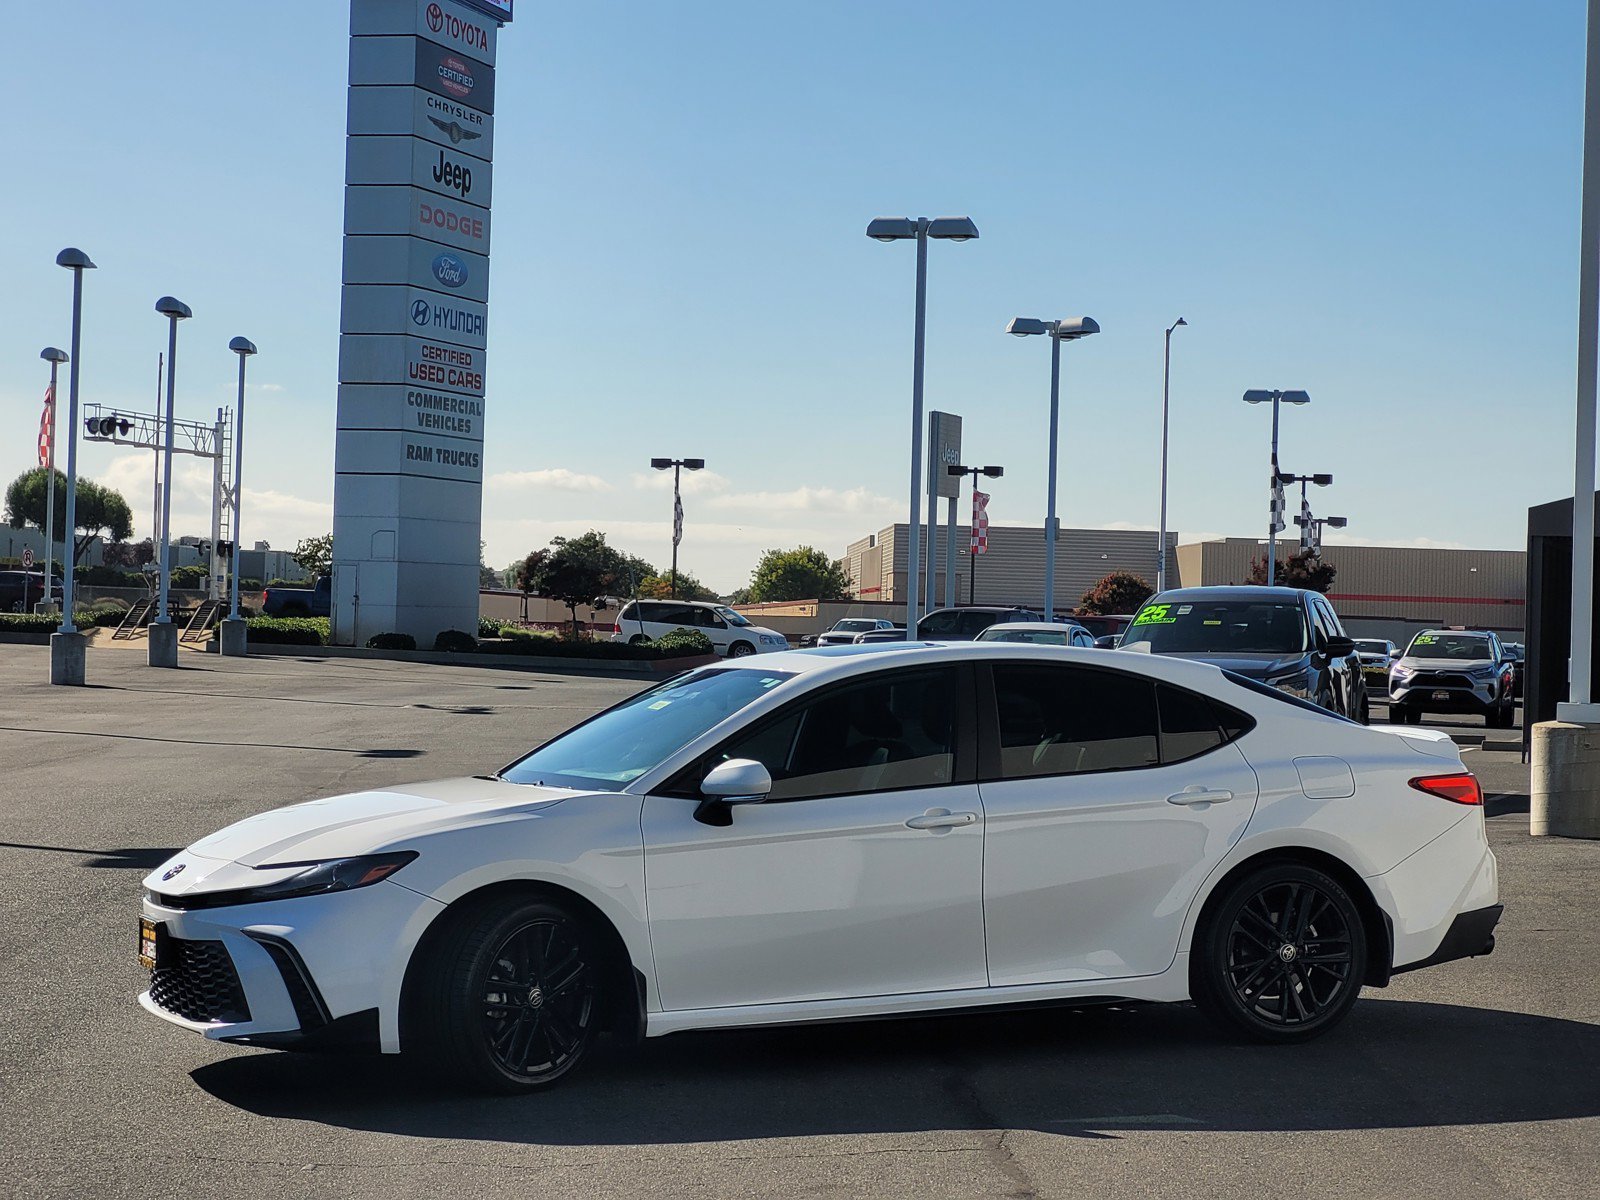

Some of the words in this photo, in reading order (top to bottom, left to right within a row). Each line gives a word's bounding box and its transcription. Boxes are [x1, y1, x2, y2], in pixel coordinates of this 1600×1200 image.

[444, 14, 488, 52] TOYOTA
[438, 65, 474, 88] CERTIFIED
[427, 97, 483, 126] CHRYSLER
[432, 150, 472, 197] Jeep
[419, 204, 483, 239] DODGE
[438, 257, 461, 283] Ford
[433, 305, 485, 337] HYUNDAI
[422, 345, 472, 366] CERTIFIED
[409, 361, 445, 384] USED
[448, 369, 482, 390] CARS
[407, 391, 482, 417] COMMERCIAL
[417, 412, 471, 434] VEHICLES
[406, 444, 433, 462] RAM
[436, 448, 479, 468] TRUCKS
[943, 442, 960, 466] Jeep
[1138, 604, 1172, 621] 25
